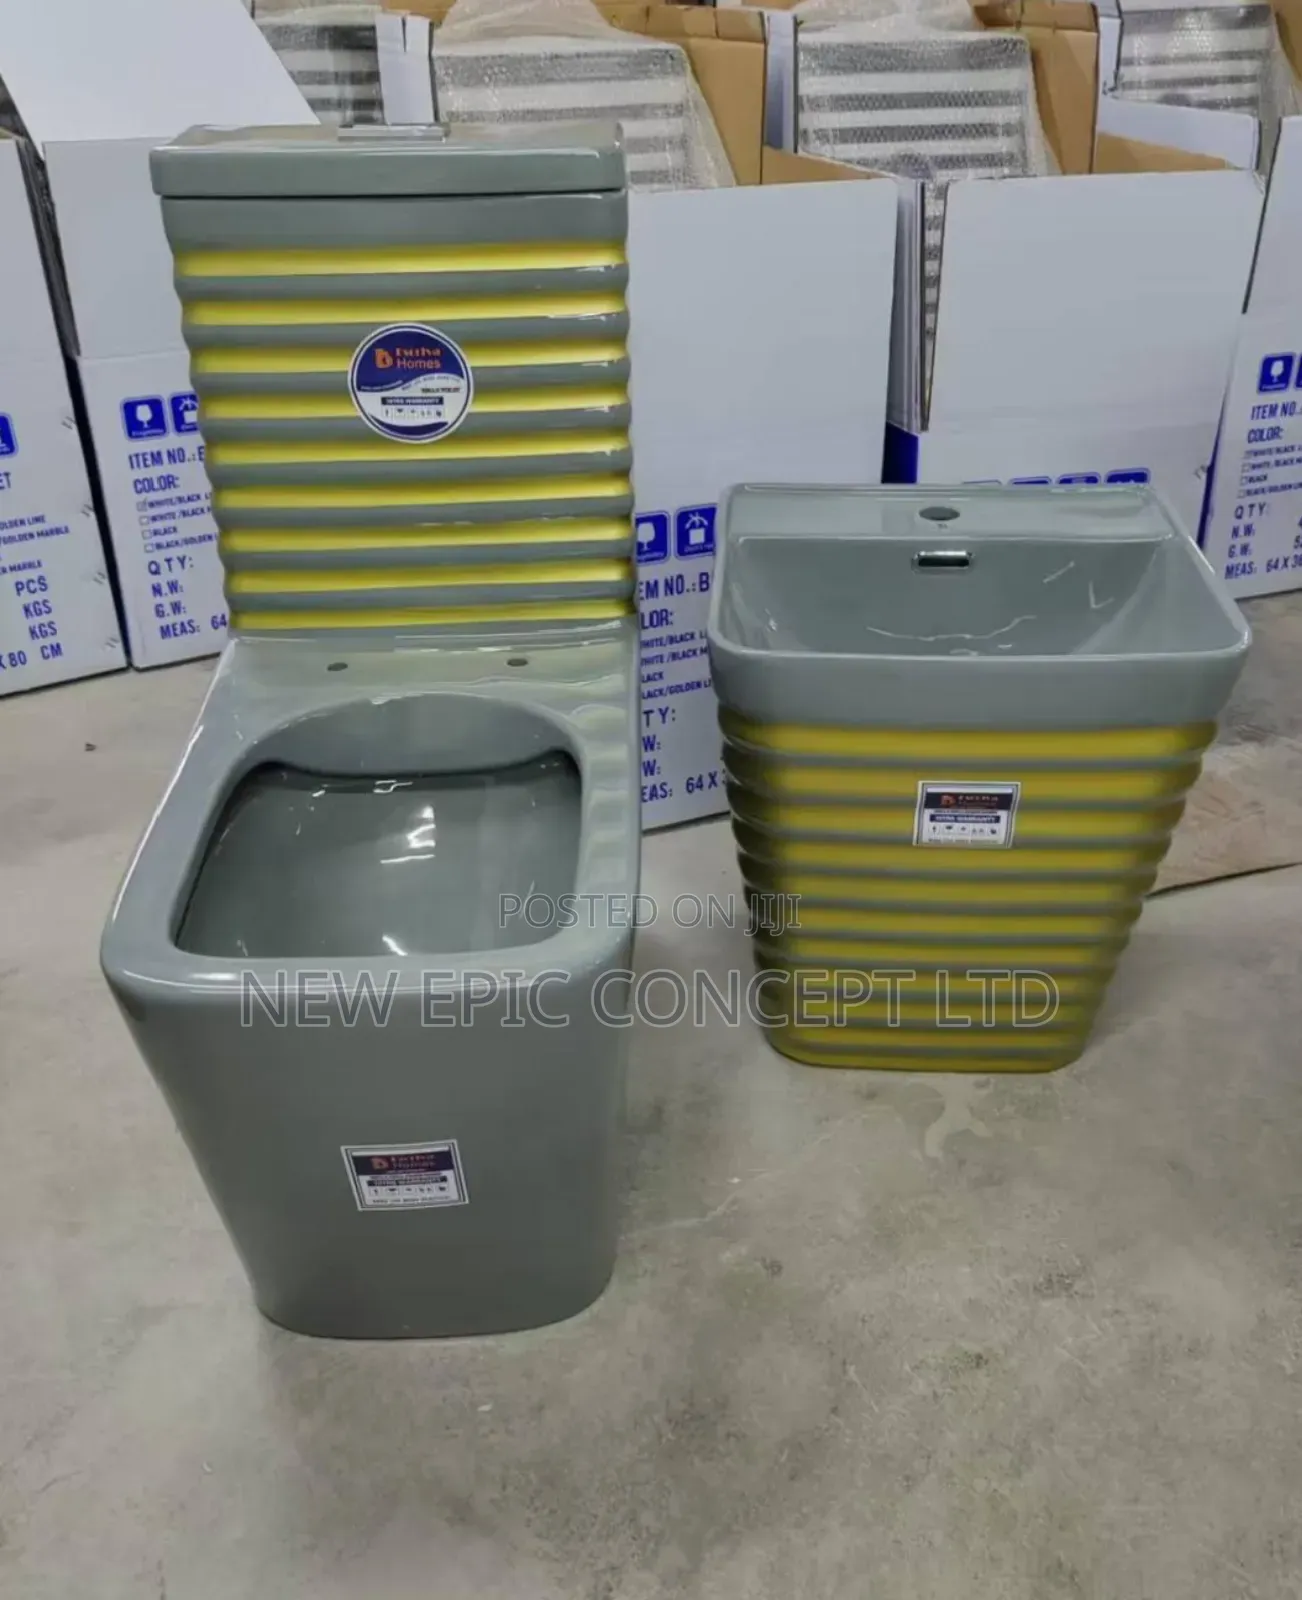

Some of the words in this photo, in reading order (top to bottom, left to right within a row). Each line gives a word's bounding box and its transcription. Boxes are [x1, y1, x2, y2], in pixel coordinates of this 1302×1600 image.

[1251, 403, 1278, 420] ITEM
[1247, 426, 1283, 444] COLOR:
[128, 449, 163, 470] ITEM
[133, 474, 179, 494] COLOR:
[1224, 561, 1258, 580] MEAS:
[15, 575, 49, 597] PCS
[22, 599, 53, 620] KGS
[29, 621, 58, 641] KGS
[160, 618, 201, 640] MEAS:
[210, 613, 227, 631] 64
[8, 650, 28, 668] 80
[40, 641, 63, 661] CM
[685, 773, 704, 795] 64
